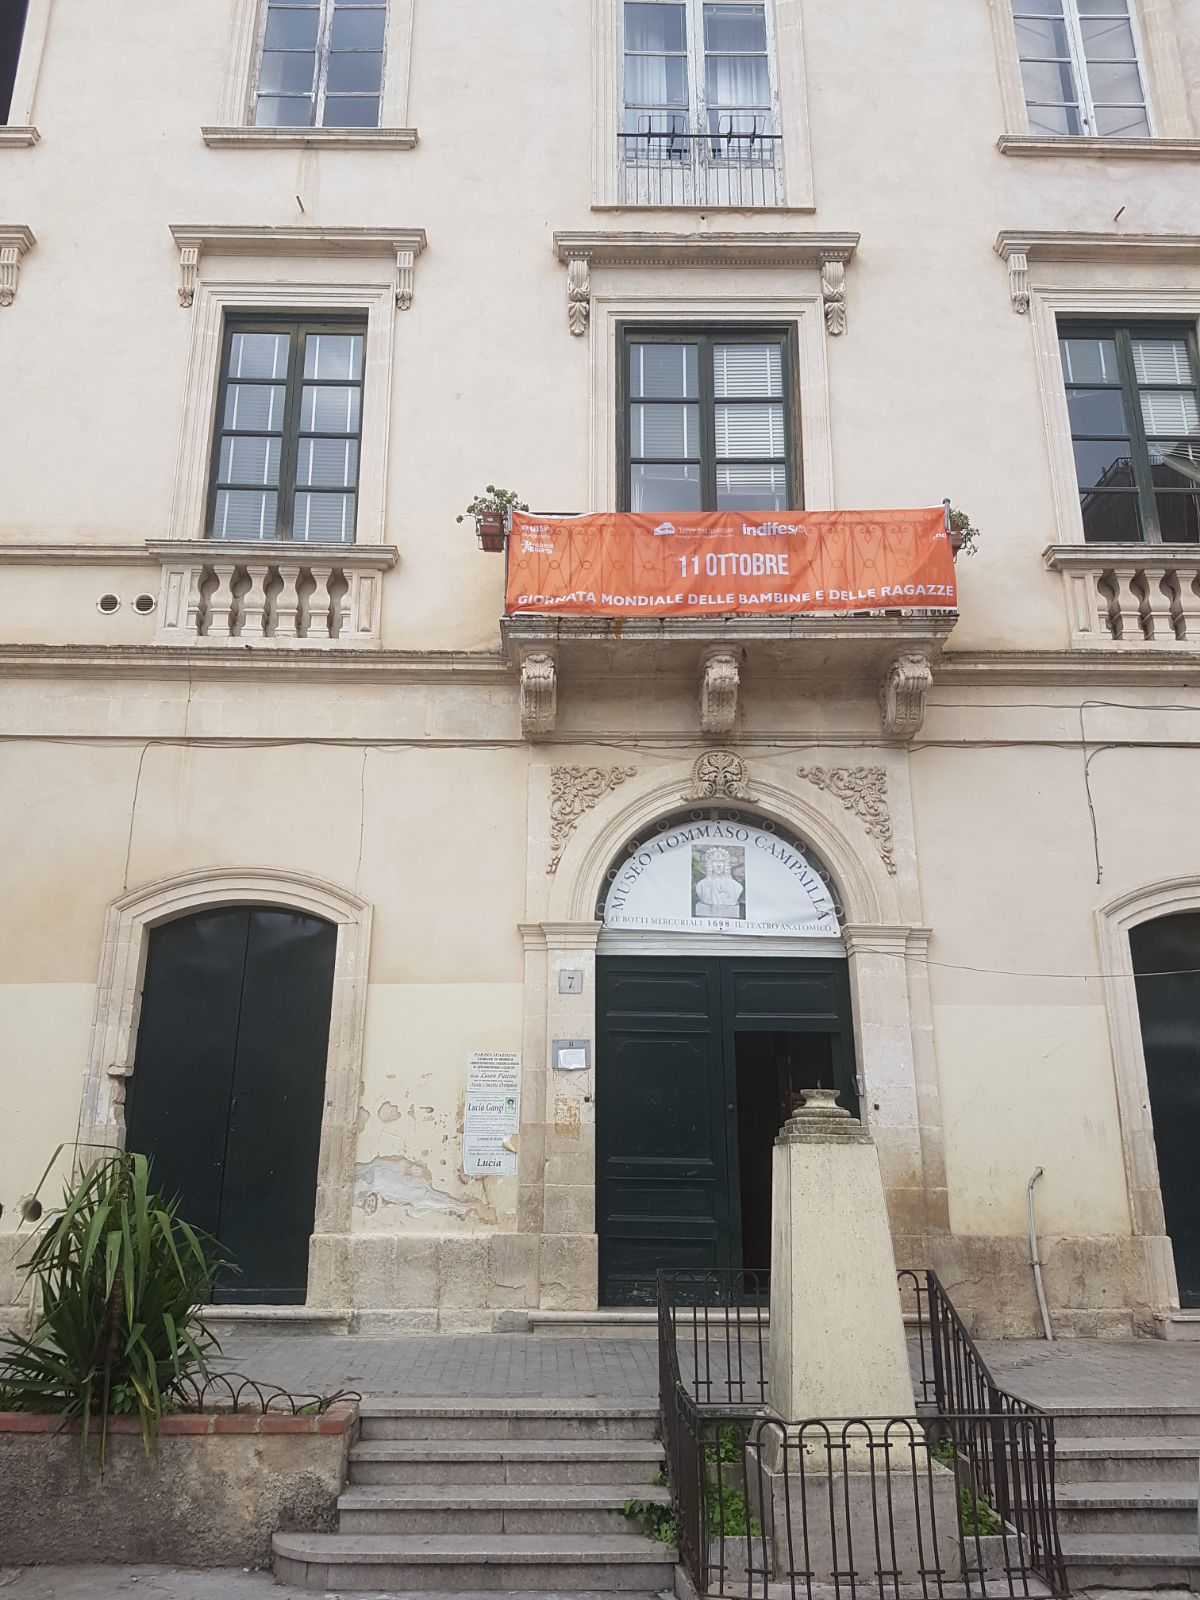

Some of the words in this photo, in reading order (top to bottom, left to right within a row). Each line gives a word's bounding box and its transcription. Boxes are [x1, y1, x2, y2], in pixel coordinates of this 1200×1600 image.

[679, 555, 699, 577] 11
[706, 552, 789, 576] OTTOBRE
[518, 591, 597, 605] GIORNATA
[602, 593, 684, 606] MONDIALE
[688, 593, 734, 605] DELLE
[739, 592, 811, 604] BAMBINE
[816, 590, 824, 600] E
[829, 588, 876, 601] DELLE
[881, 584, 954, 597] RAGAZZE
[611, 852, 652, 911] MUSEO
[652, 825, 749, 855] TOMMASO
[754, 835, 831, 921] CAMPAILLA
[622, 915, 649, 924] BOTTI
[651, 917, 703, 927] MERCURIALI
[707, 919, 730, 928] 1698
[745, 921, 779, 930] TEATRO
[781, 922, 832, 932] ANATOMICO
[567, 976, 575, 989] 7
[468, 1102, 485, 1112] Lucia
[477, 1158, 502, 1167] Lucia
